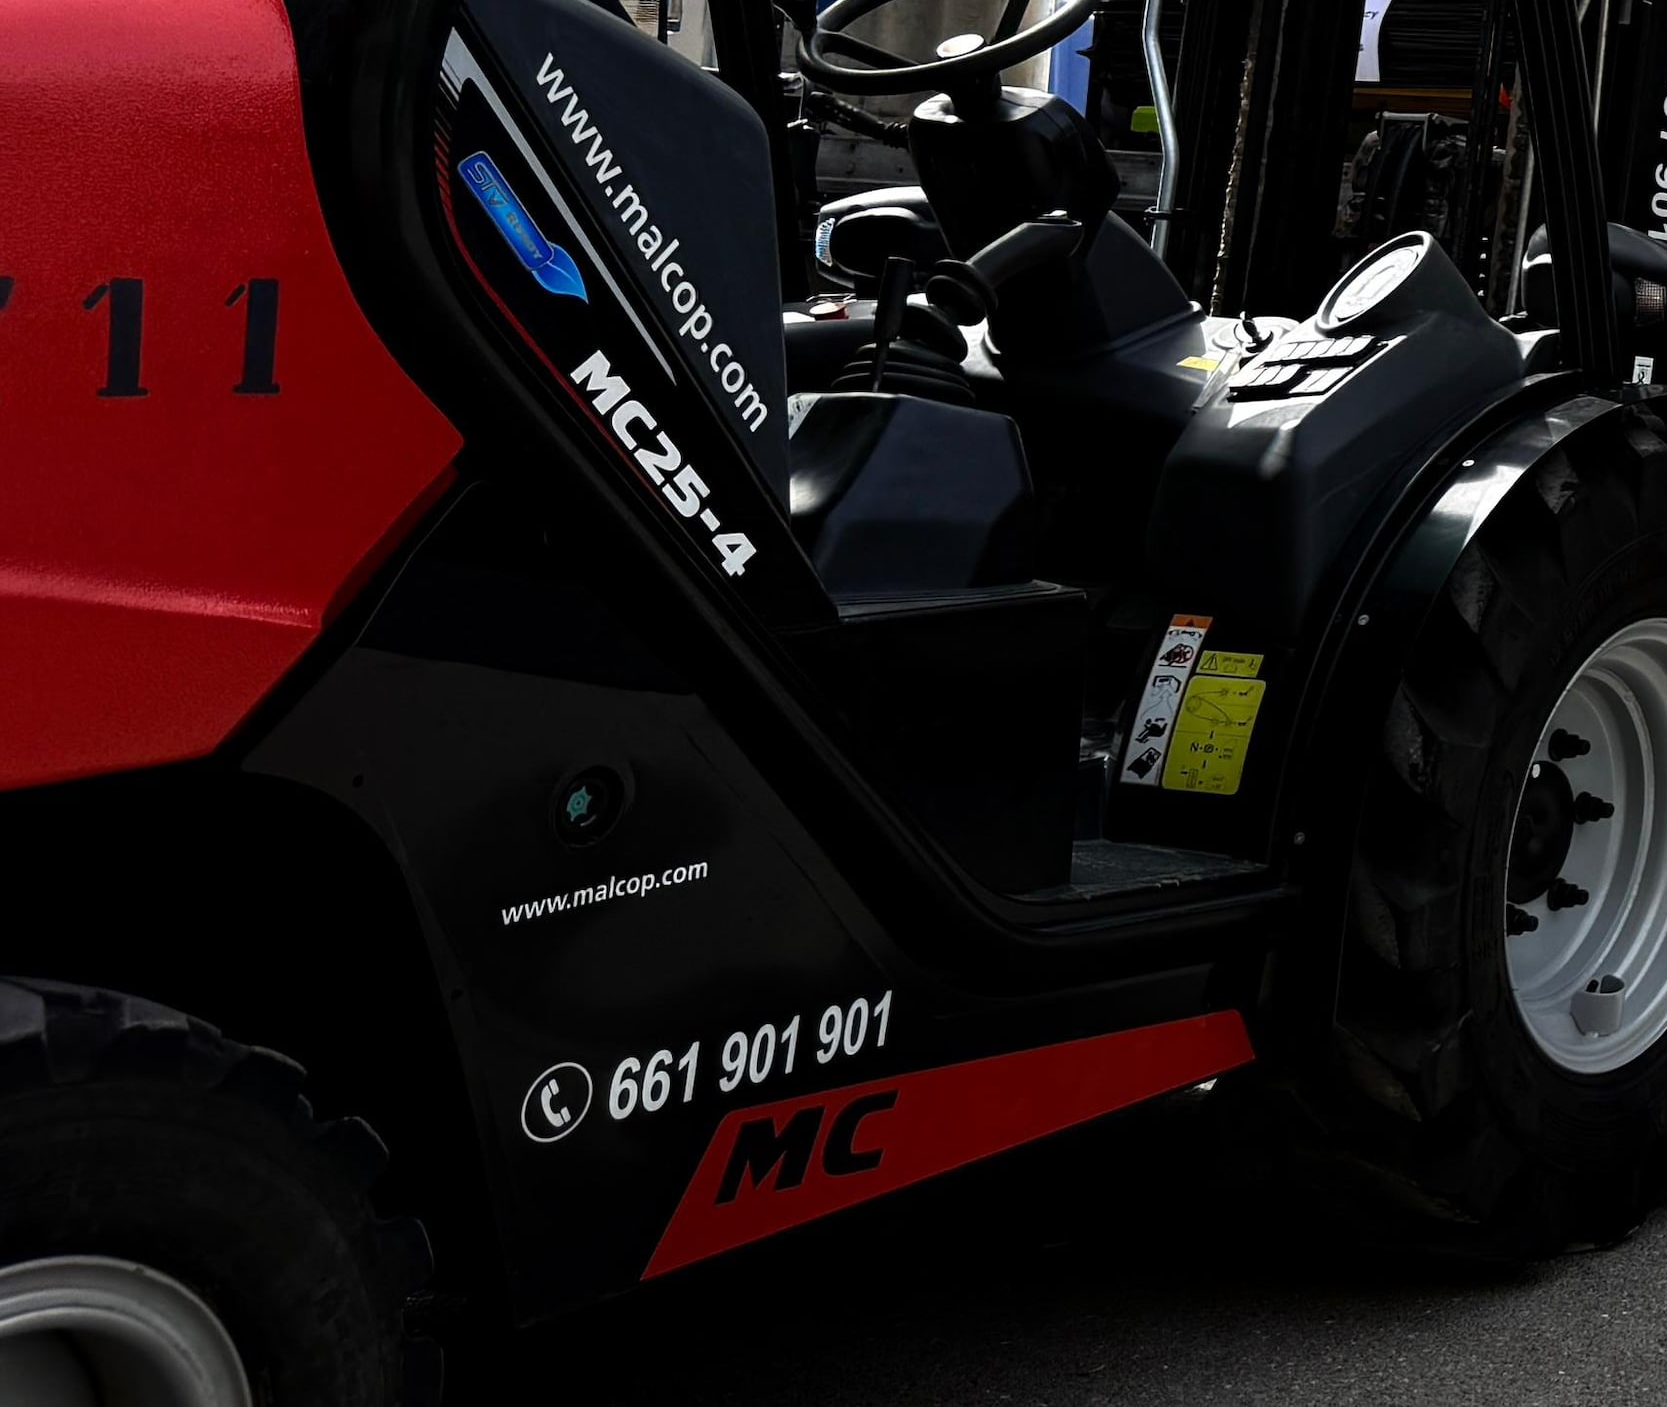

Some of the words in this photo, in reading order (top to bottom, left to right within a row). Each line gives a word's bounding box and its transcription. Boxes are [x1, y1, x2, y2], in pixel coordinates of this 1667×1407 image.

[535, 51, 768, 434] www.malcop.com
[569, 349, 757, 578] MC25-4
[500, 860, 709, 926] www.malcop.com
[608, 1041, 700, 1120] 661
[719, 1014, 800, 1093] 901
[816, 990, 892, 1065] 901
[715, 1089, 901, 1207] MC
